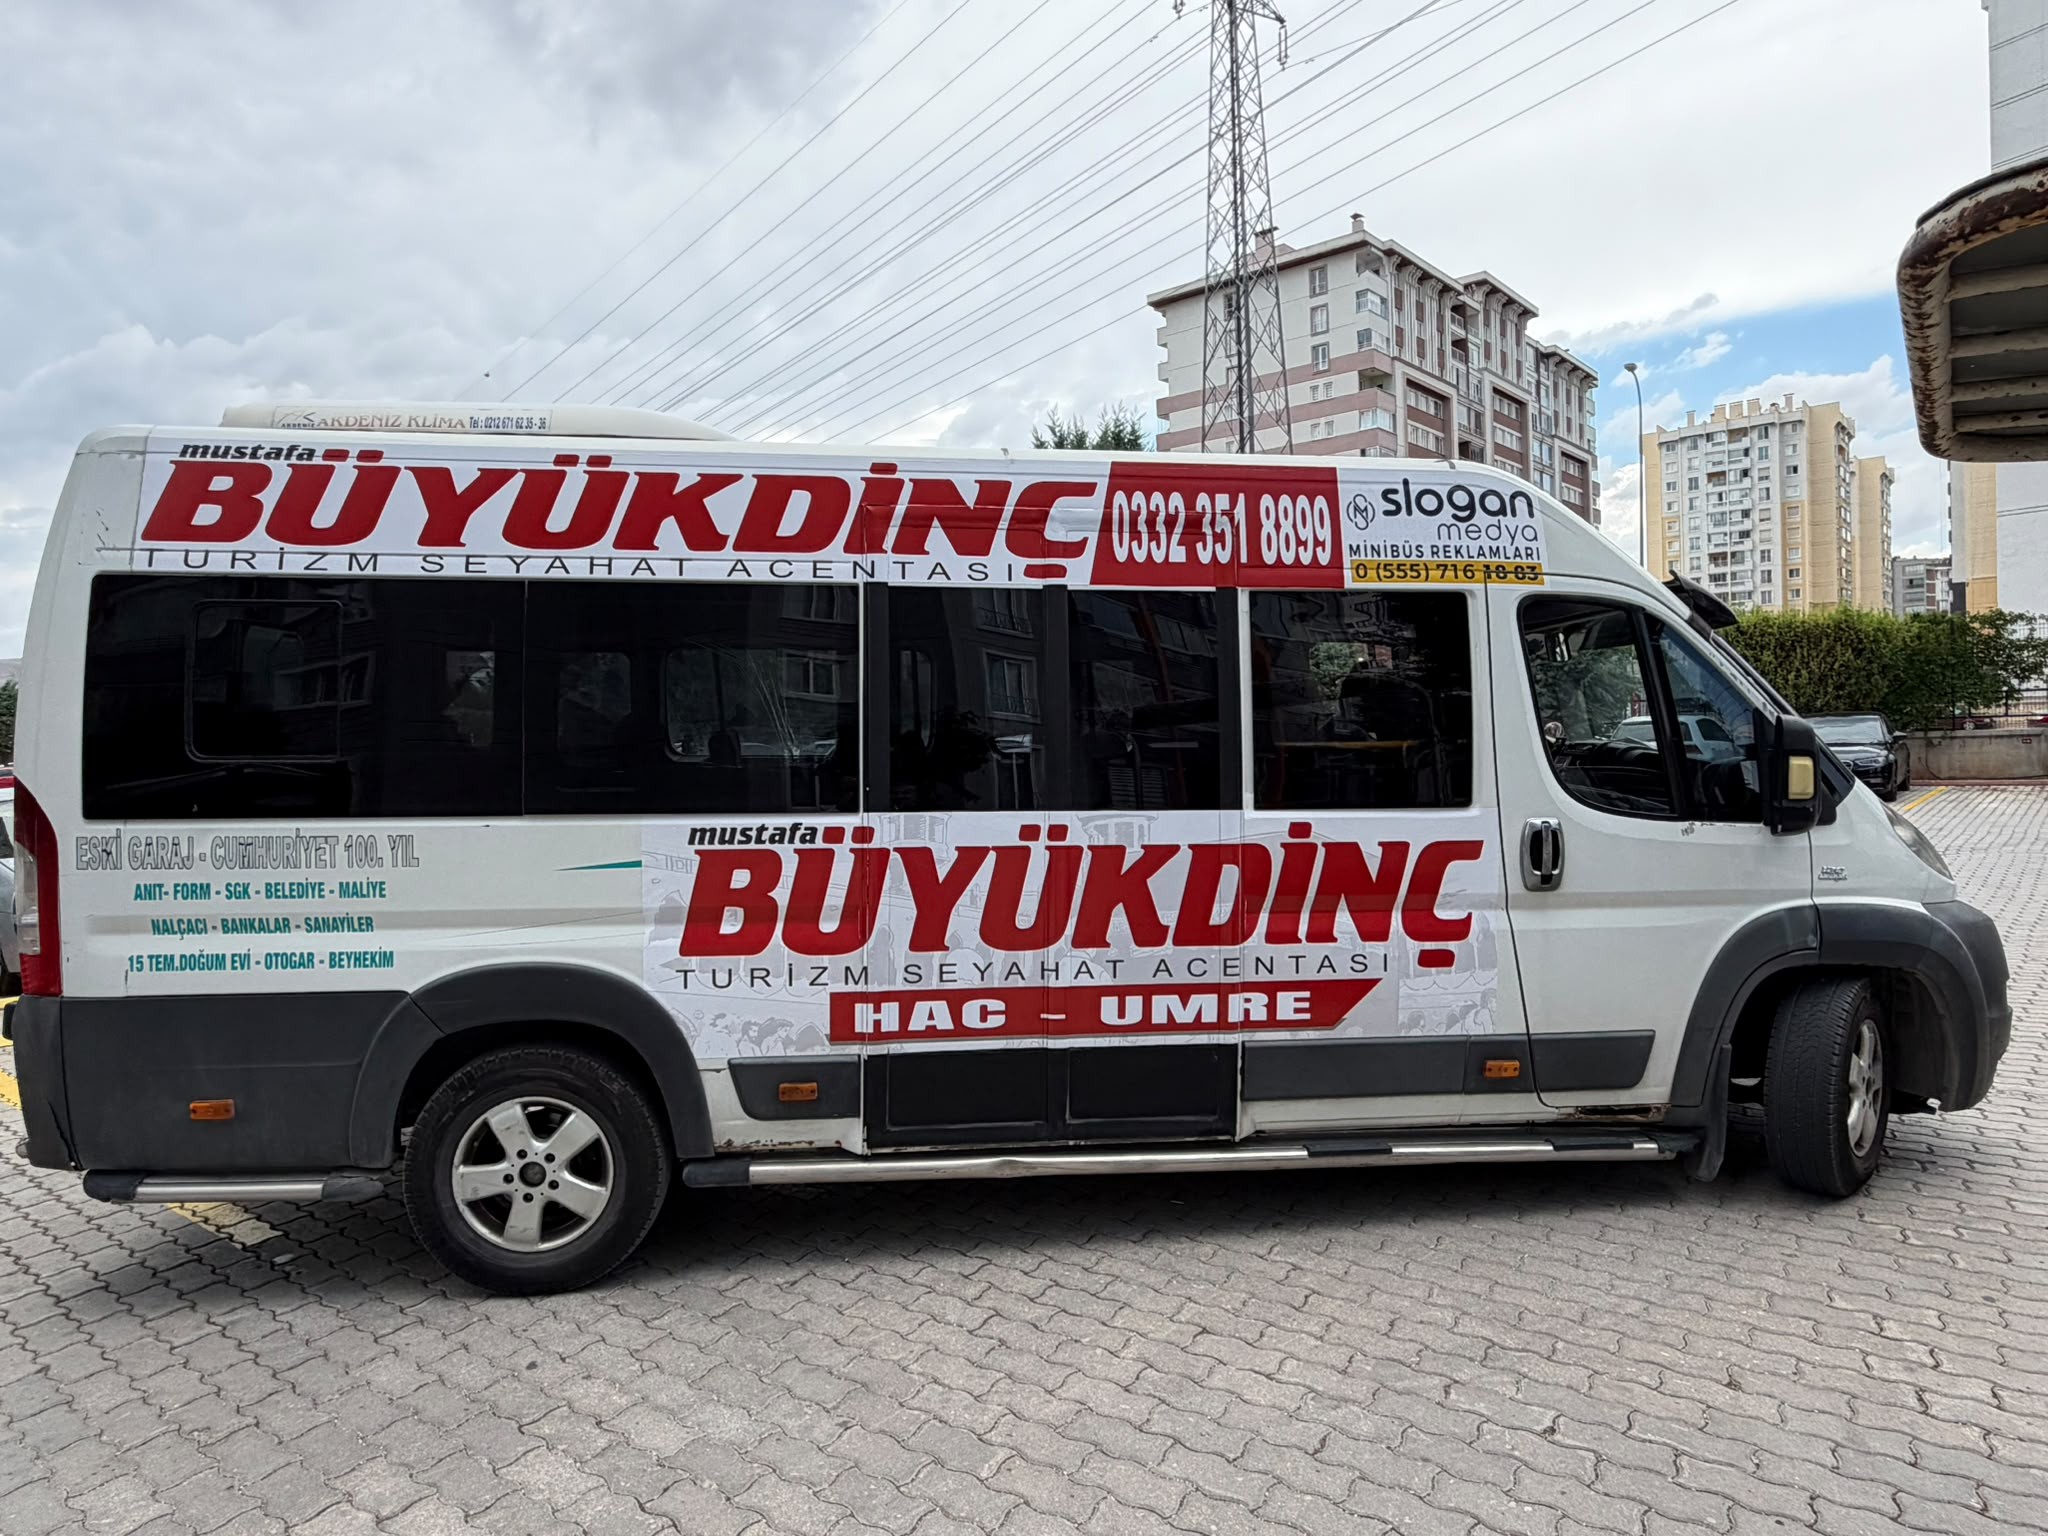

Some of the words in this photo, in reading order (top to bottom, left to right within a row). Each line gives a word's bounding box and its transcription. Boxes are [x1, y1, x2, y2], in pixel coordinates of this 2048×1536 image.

[407, 413, 466, 429] KLİMA
[484, 416, 500, 429] 0212
[501, 416, 514, 429] 671
[515, 416, 524, 430] 62
[179, 443, 316, 463] mustafa
[140, 448, 1098, 579] BÜYÜKDİNÇ
[1381, 478, 1536, 523] slogan
[1112, 490, 1187, 564] 0332
[1195, 492, 1248, 565] 351
[1259, 493, 1332, 566] 8899
[1437, 519, 1539, 546] medya
[140, 546, 380, 573] TURİZM
[420, 554, 690, 577] SEYAHAT
[726, 559, 1013, 582] ACENTASI
[1349, 539, 1425, 559] MİNİBÜS
[1430, 544, 1541, 561] REKLAMLARI
[1355, 563, 1369, 579] 0
[1375, 562, 1430, 582] (555)
[1436, 563, 1476, 580] 716
[688, 822, 818, 846] mustafa
[75, 828, 123, 871] ESKİ
[128, 836, 195, 871] GARAJ
[210, 827, 339, 871] CUMHURİYET
[344, 834, 384, 869] 100.
[387, 834, 420, 868] YIL
[173, 882, 211, 900] FORM
[225, 882, 251, 900] SGK
[265, 877, 326, 900] BELEDİYE
[339, 877, 387, 899] MALİYE
[678, 821, 1485, 968] BÜYÜKDİNÇ
[150, 918, 208, 940] NALÇACI
[221, 917, 292, 935] BANKALAR
[304, 912, 375, 934] SANAYİLER
[128, 954, 145, 973] 15
[230, 948, 251, 971] EVİ
[264, 951, 316, 970] OTOGAR
[328, 946, 395, 969] BEYHEKİM
[675, 961, 870, 990] TURİZM
[903, 957, 1125, 984] SEYAHAT
[1152, 952, 1389, 978] ACENTASI
[853, 998, 1007, 1034] HAC
[1040, 1013, 1067, 1021] -
[1099, 990, 1312, 1026] UMRE
